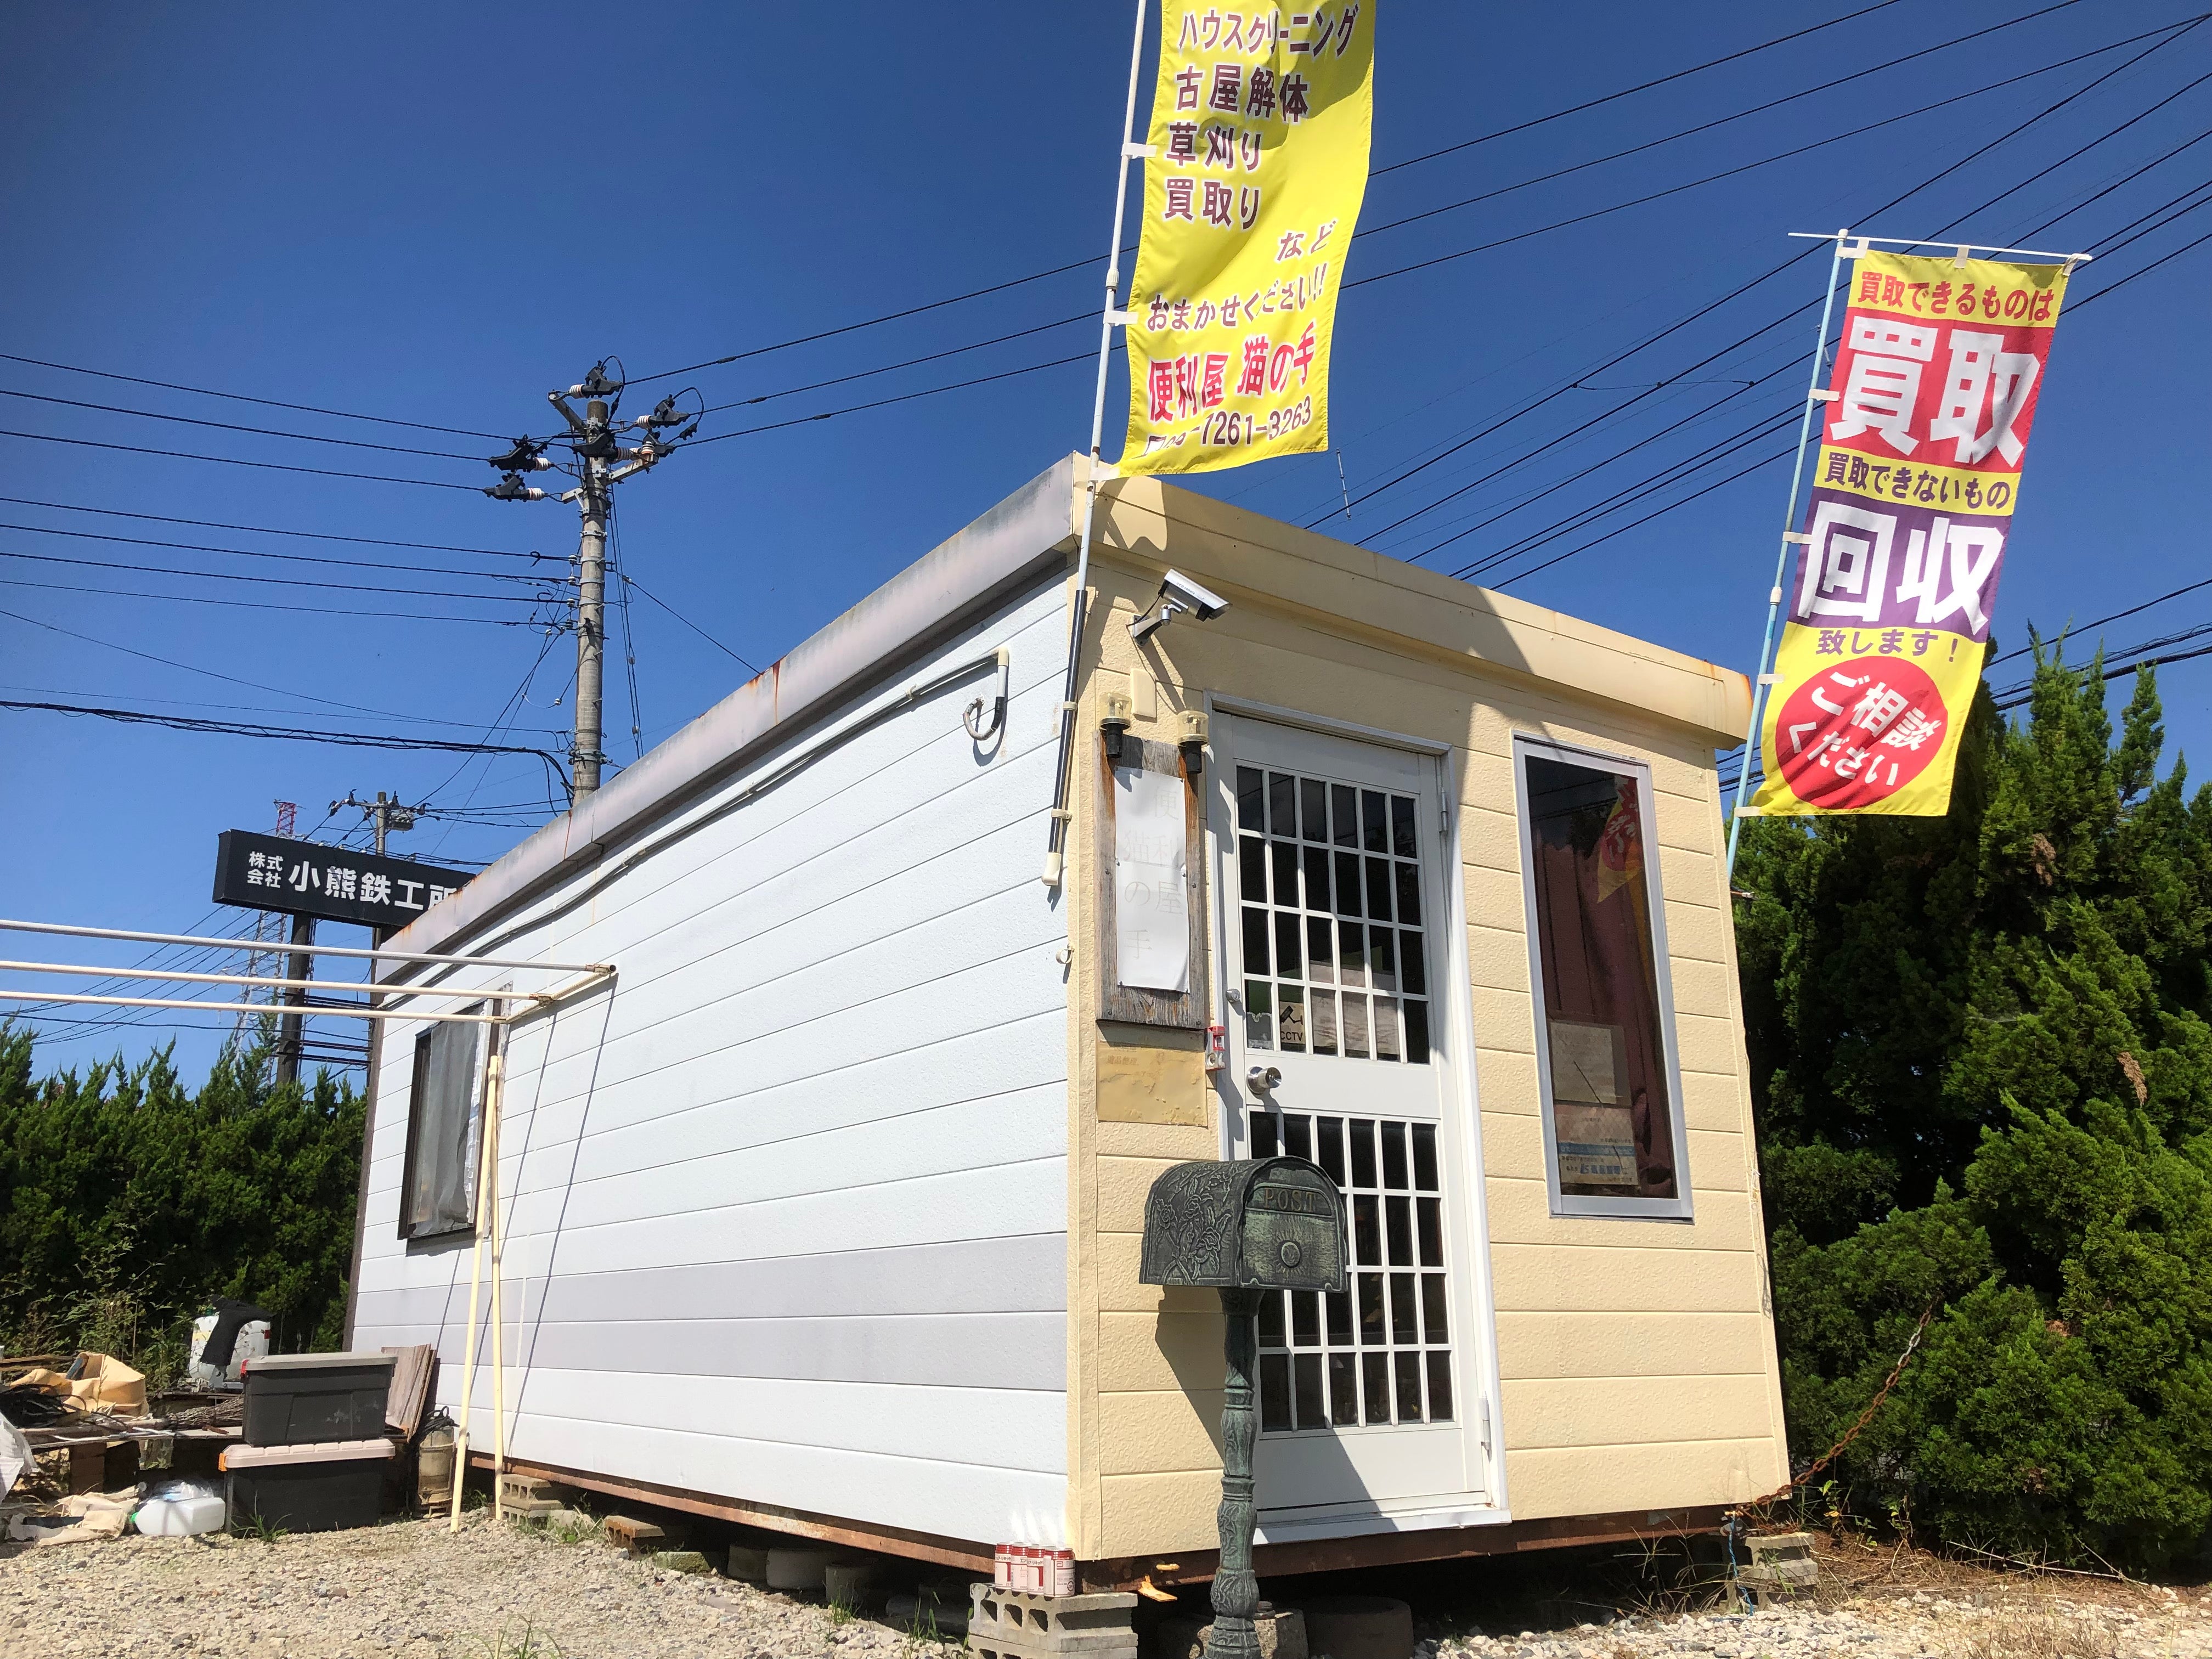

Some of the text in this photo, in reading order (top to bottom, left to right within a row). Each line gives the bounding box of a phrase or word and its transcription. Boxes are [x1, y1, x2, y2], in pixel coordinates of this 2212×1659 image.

[1179, 3, 1359, 57] ハウスクリーニング
[1176, 64, 1309, 122] 古屋解体
[1166, 122, 1261, 171] 草刈り
[1164, 178, 1261, 229] 買取り
[1277, 220, 1337, 261] など
[1858, 272, 2055, 321] 買取できるものは
[1149, 321, 1316, 422] 便利屋 猫の手
[1830, 315, 2040, 468] 買取
[1824, 452, 2011, 510] 買取できないもの
[1798, 500, 2005, 635] 回収
[1816, 629, 1959, 662] 致します！
[1811, 671, 1942, 752] ご相談
[1788, 721, 1899, 786] ください
[247, 868, 281, 889] 会社
[249, 851, 284, 872] 株式
[1280, 1031, 1303, 1041] CCTV
[1263, 1188, 1317, 1212] POST
